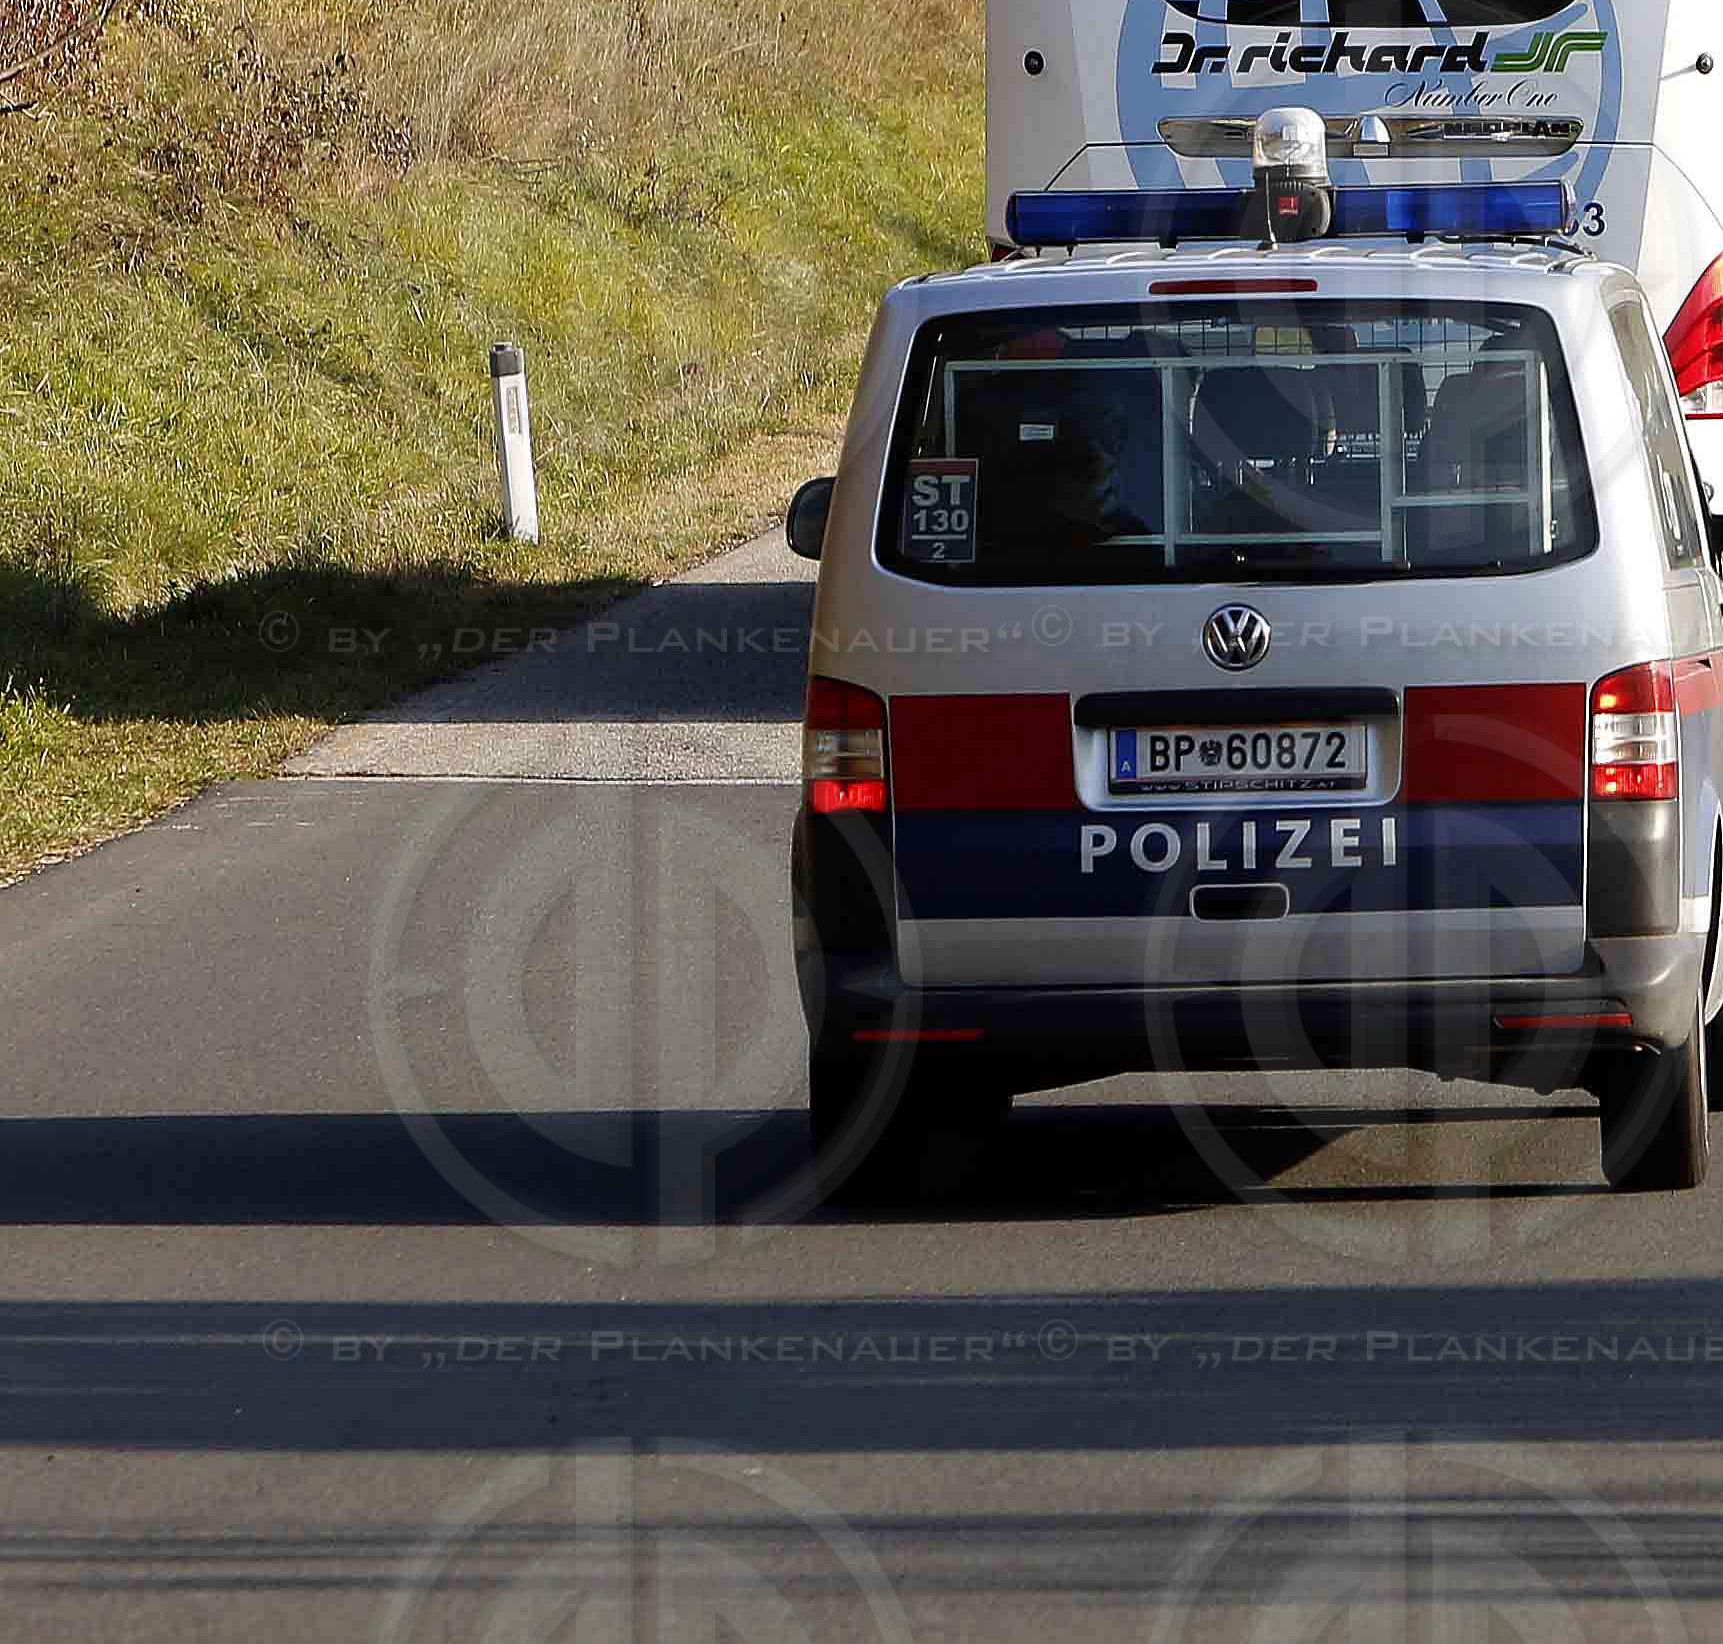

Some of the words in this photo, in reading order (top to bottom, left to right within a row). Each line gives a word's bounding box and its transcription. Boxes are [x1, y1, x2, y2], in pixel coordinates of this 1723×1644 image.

[1383, 79, 1501, 108] Number
[1505, 79, 1561, 107] One
[911, 475, 970, 506] ST
[912, 509, 969, 532] 130
[932, 542, 945, 559] 2
[1119, 760, 1132, 773] A
[1149, 734, 1196, 773] BP
[1226, 731, 1347, 771] 60872
[1080, 816, 1397, 874] POLIZEI
